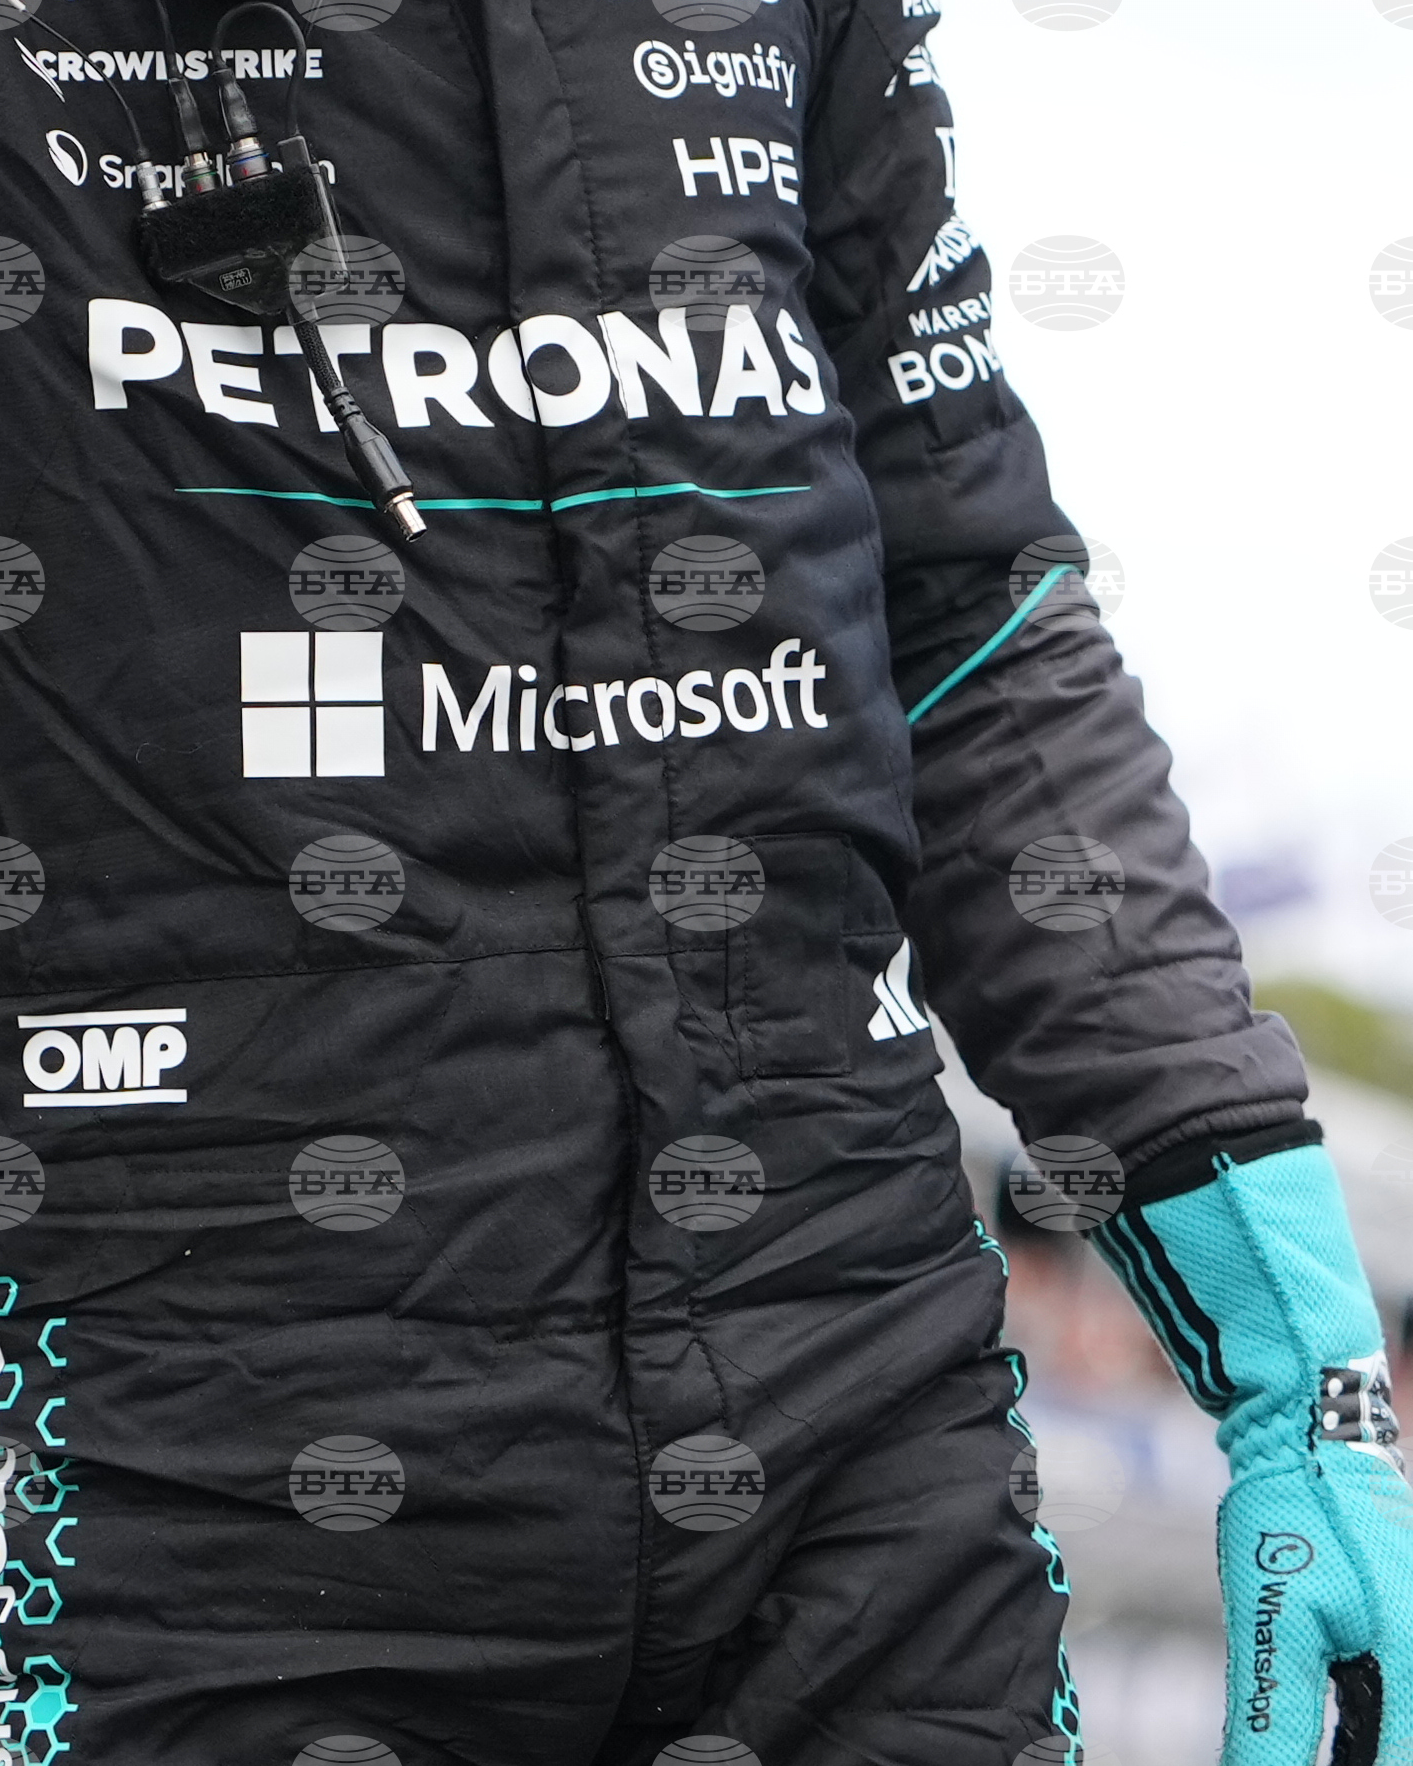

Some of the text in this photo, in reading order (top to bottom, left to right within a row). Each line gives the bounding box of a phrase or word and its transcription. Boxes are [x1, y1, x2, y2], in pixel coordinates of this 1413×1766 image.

[633, 40, 796, 107] Signify
[672, 138, 799, 205] HPE
[908, 292, 992, 337] MARRI
[87, 297, 827, 432] PETRONAS
[888, 328, 1002, 405] BON
[422, 638, 829, 753] Microsoft
[22, 1024, 188, 1092] OMP
[1246, 1580, 1289, 1734] WhatsApp
